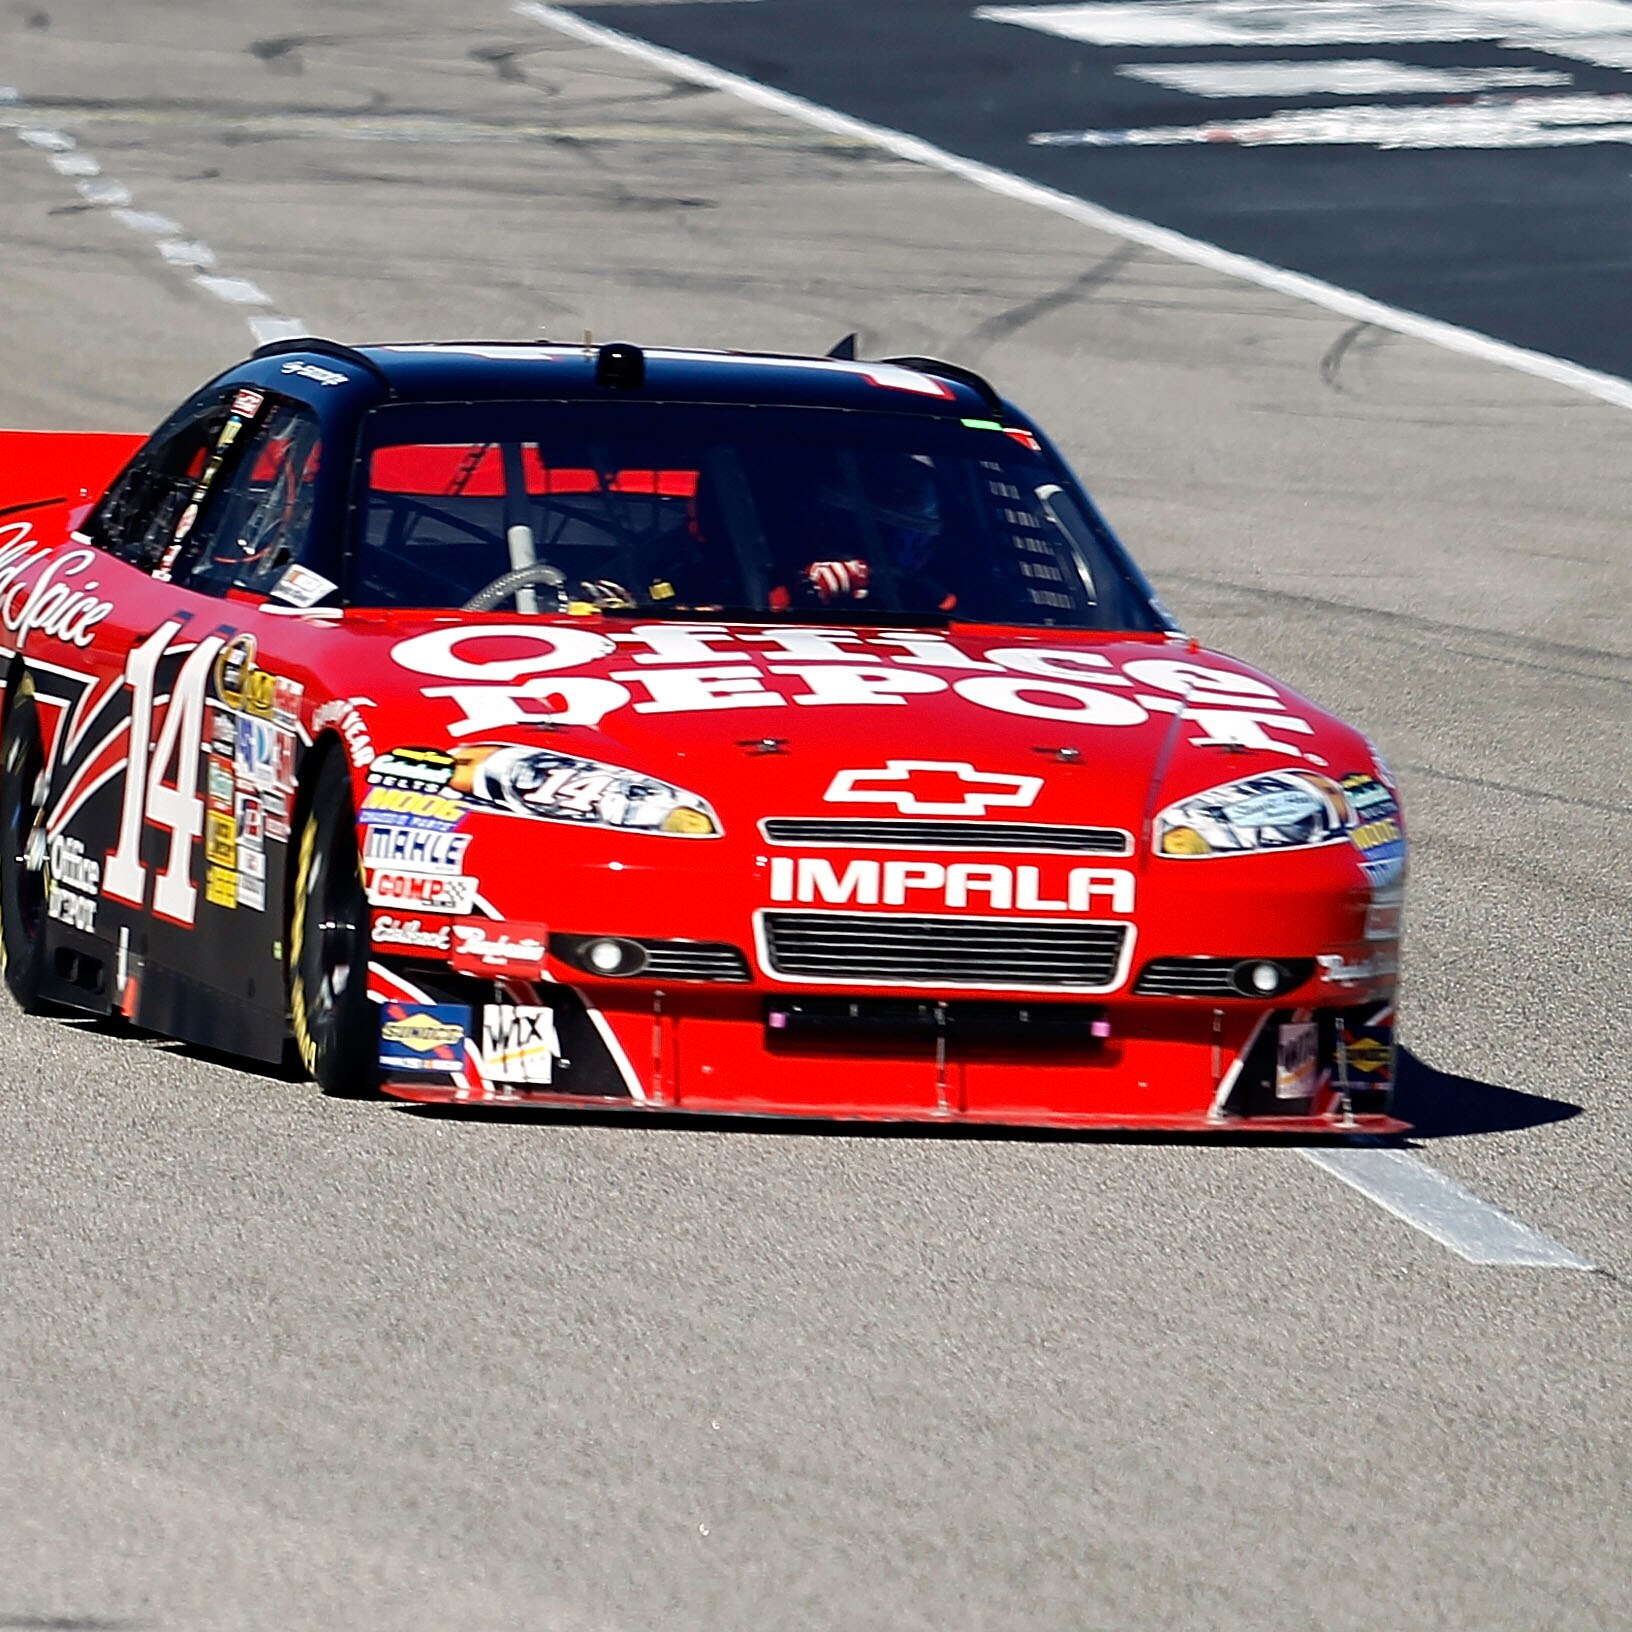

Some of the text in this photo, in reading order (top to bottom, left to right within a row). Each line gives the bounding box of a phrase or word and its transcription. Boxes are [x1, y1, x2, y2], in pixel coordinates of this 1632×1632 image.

[2, 549, 114, 648] Spice
[389, 623, 1288, 712] Office
[420, 663, 1318, 756] DEPOT
[103, 618, 224, 926] 14
[367, 773, 440, 793] BELTS
[523, 767, 611, 814] 14
[361, 786, 469, 822] MOOG
[366, 828, 468, 865] MAHLE
[378, 874, 444, 900] COMP
[769, 857, 1136, 914] IMPALA
[484, 1012, 546, 1052] WIX
